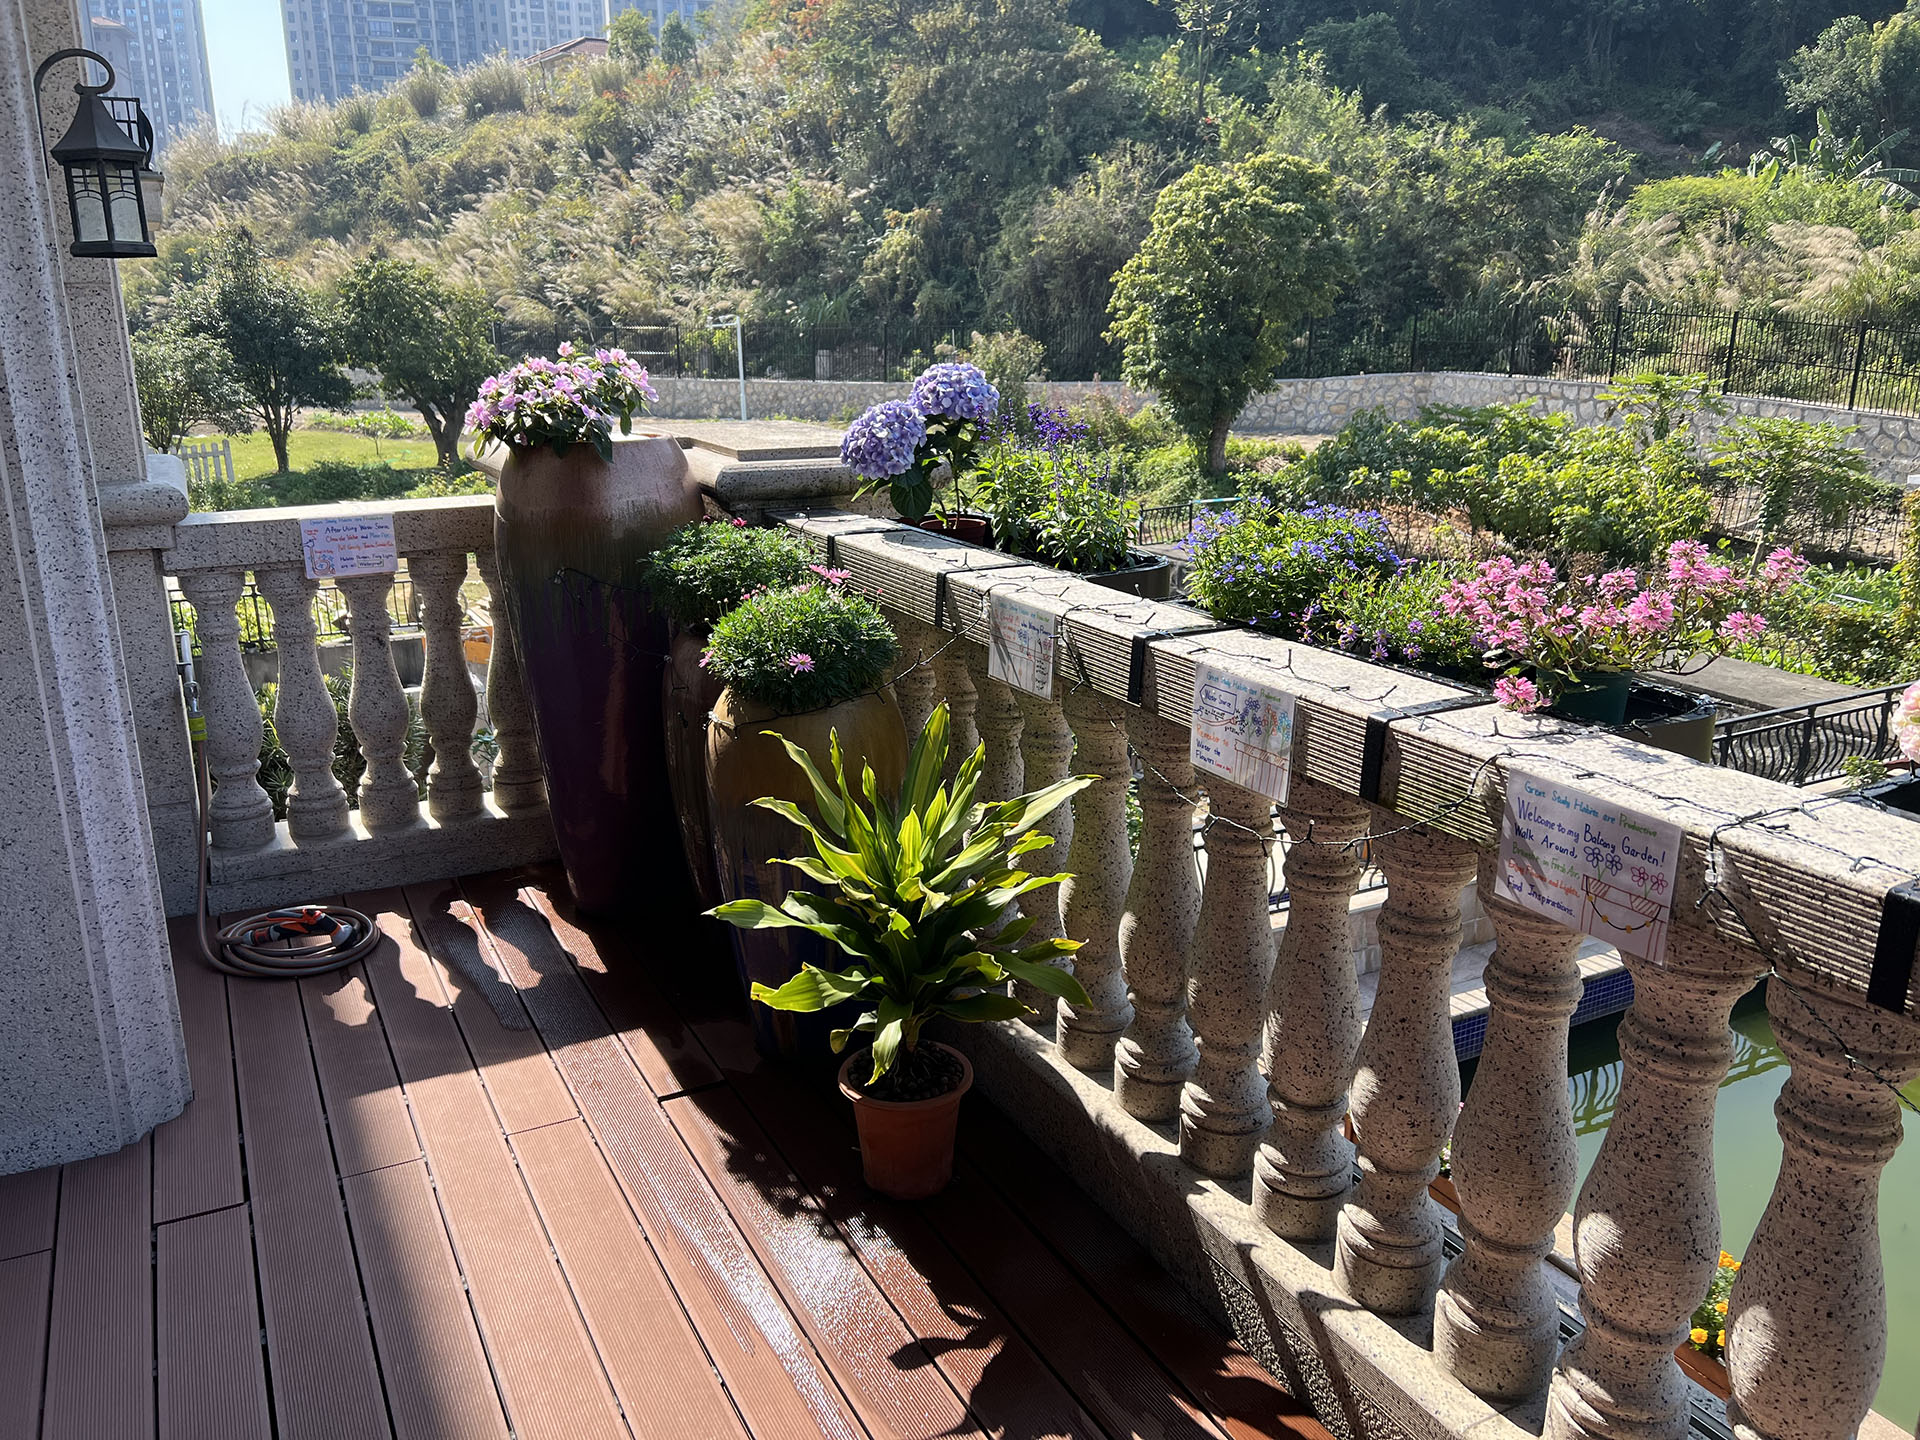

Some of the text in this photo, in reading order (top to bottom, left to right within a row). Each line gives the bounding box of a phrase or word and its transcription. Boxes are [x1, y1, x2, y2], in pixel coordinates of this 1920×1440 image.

[1551, 789, 1570, 809] Study
[1574, 798, 1599, 818] Habits
[1602, 813, 1616, 825] are
[1619, 811, 1658, 838] Productive
[1514, 823, 1578, 859] Walk Around,
[1517, 796, 1666, 868] Welcome to my Balcony Garden!
[1507, 874, 1523, 892] Find
[1551, 857, 1566, 873] Fresh
